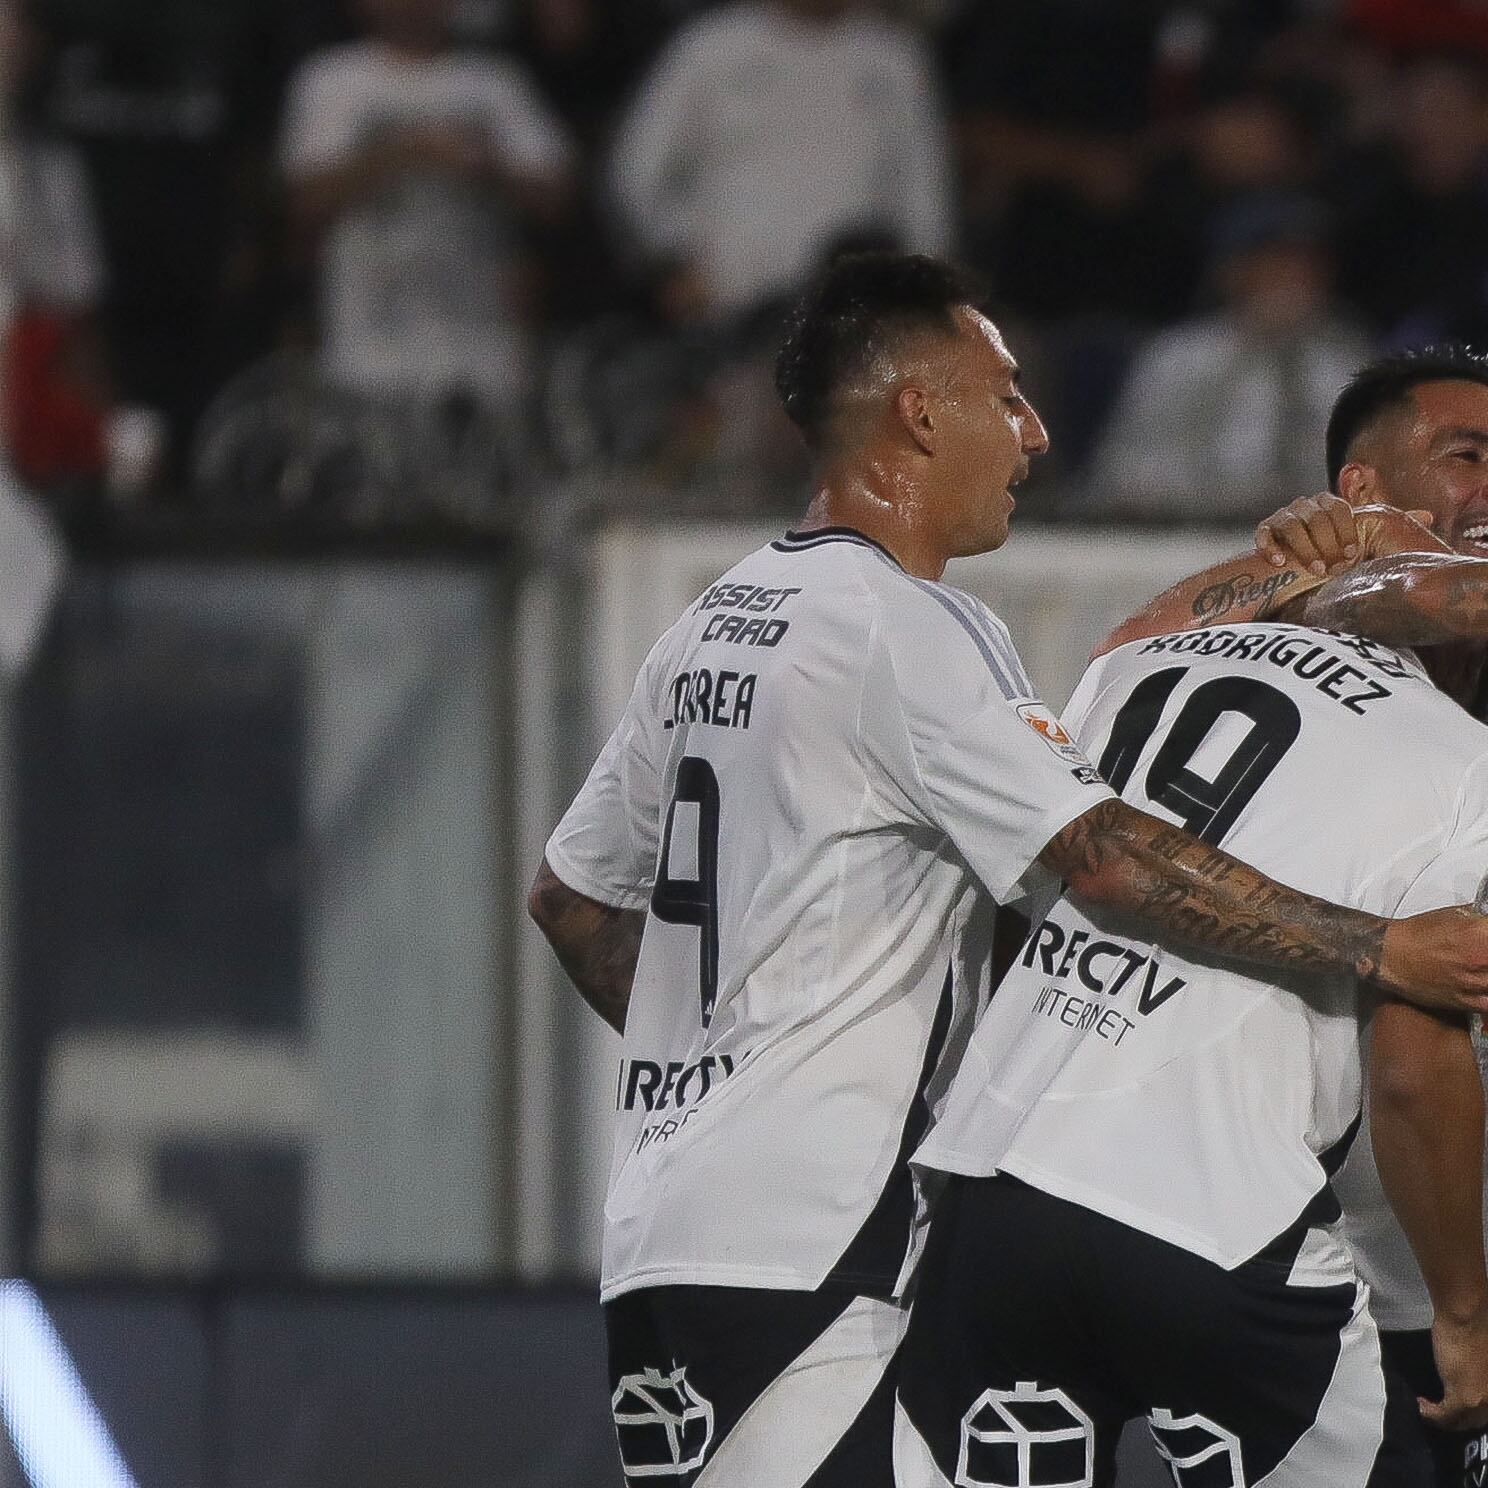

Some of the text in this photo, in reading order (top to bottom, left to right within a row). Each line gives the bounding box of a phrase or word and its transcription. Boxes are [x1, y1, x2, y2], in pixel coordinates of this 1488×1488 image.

[692, 584, 802, 616] ASSIST
[700, 613, 790, 647] CARD
[1096, 666, 1301, 849] 19
[651, 756, 720, 1029] 9
[1464, 1464, 1486, 1488] V
